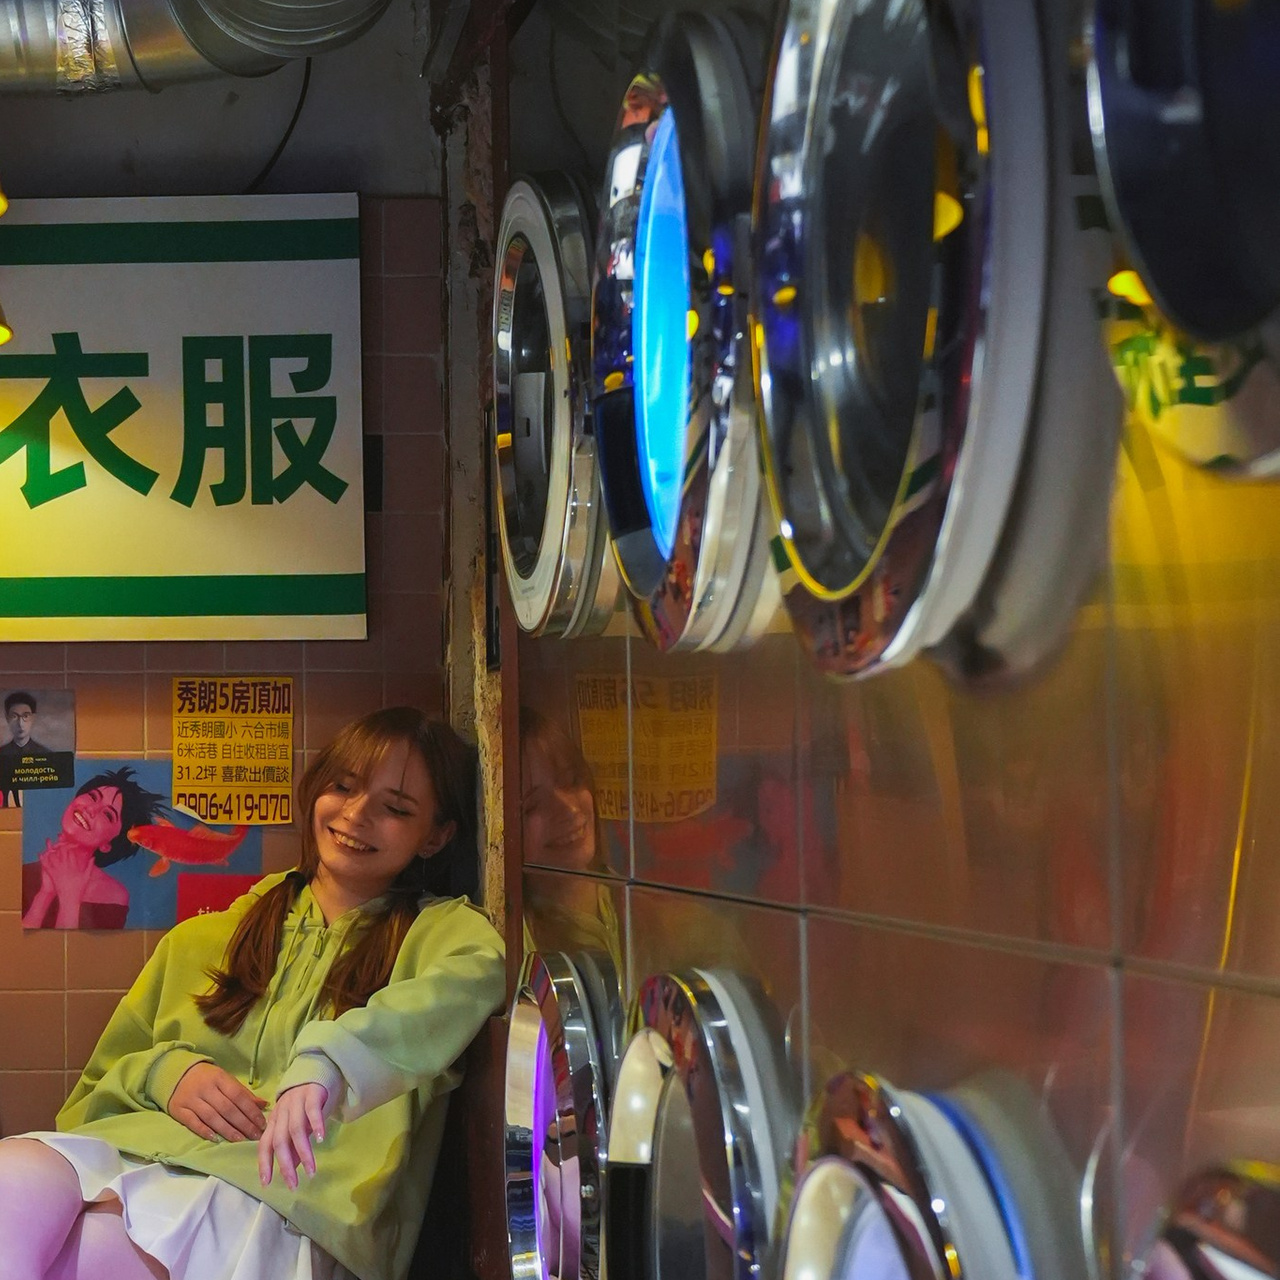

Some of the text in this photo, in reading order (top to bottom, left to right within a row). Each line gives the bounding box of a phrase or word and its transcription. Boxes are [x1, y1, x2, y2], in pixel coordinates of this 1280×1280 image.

[177, 680, 291, 714] 秀朗5房頂加
[177, 721, 290, 739] 近秀朗國小 六合市場
[176, 742, 290, 760] 6米活巷 自住收租皆宜
[14, 767, 56, 775] молодость
[176, 765, 290, 783] 31.2坪 喜歡出價談
